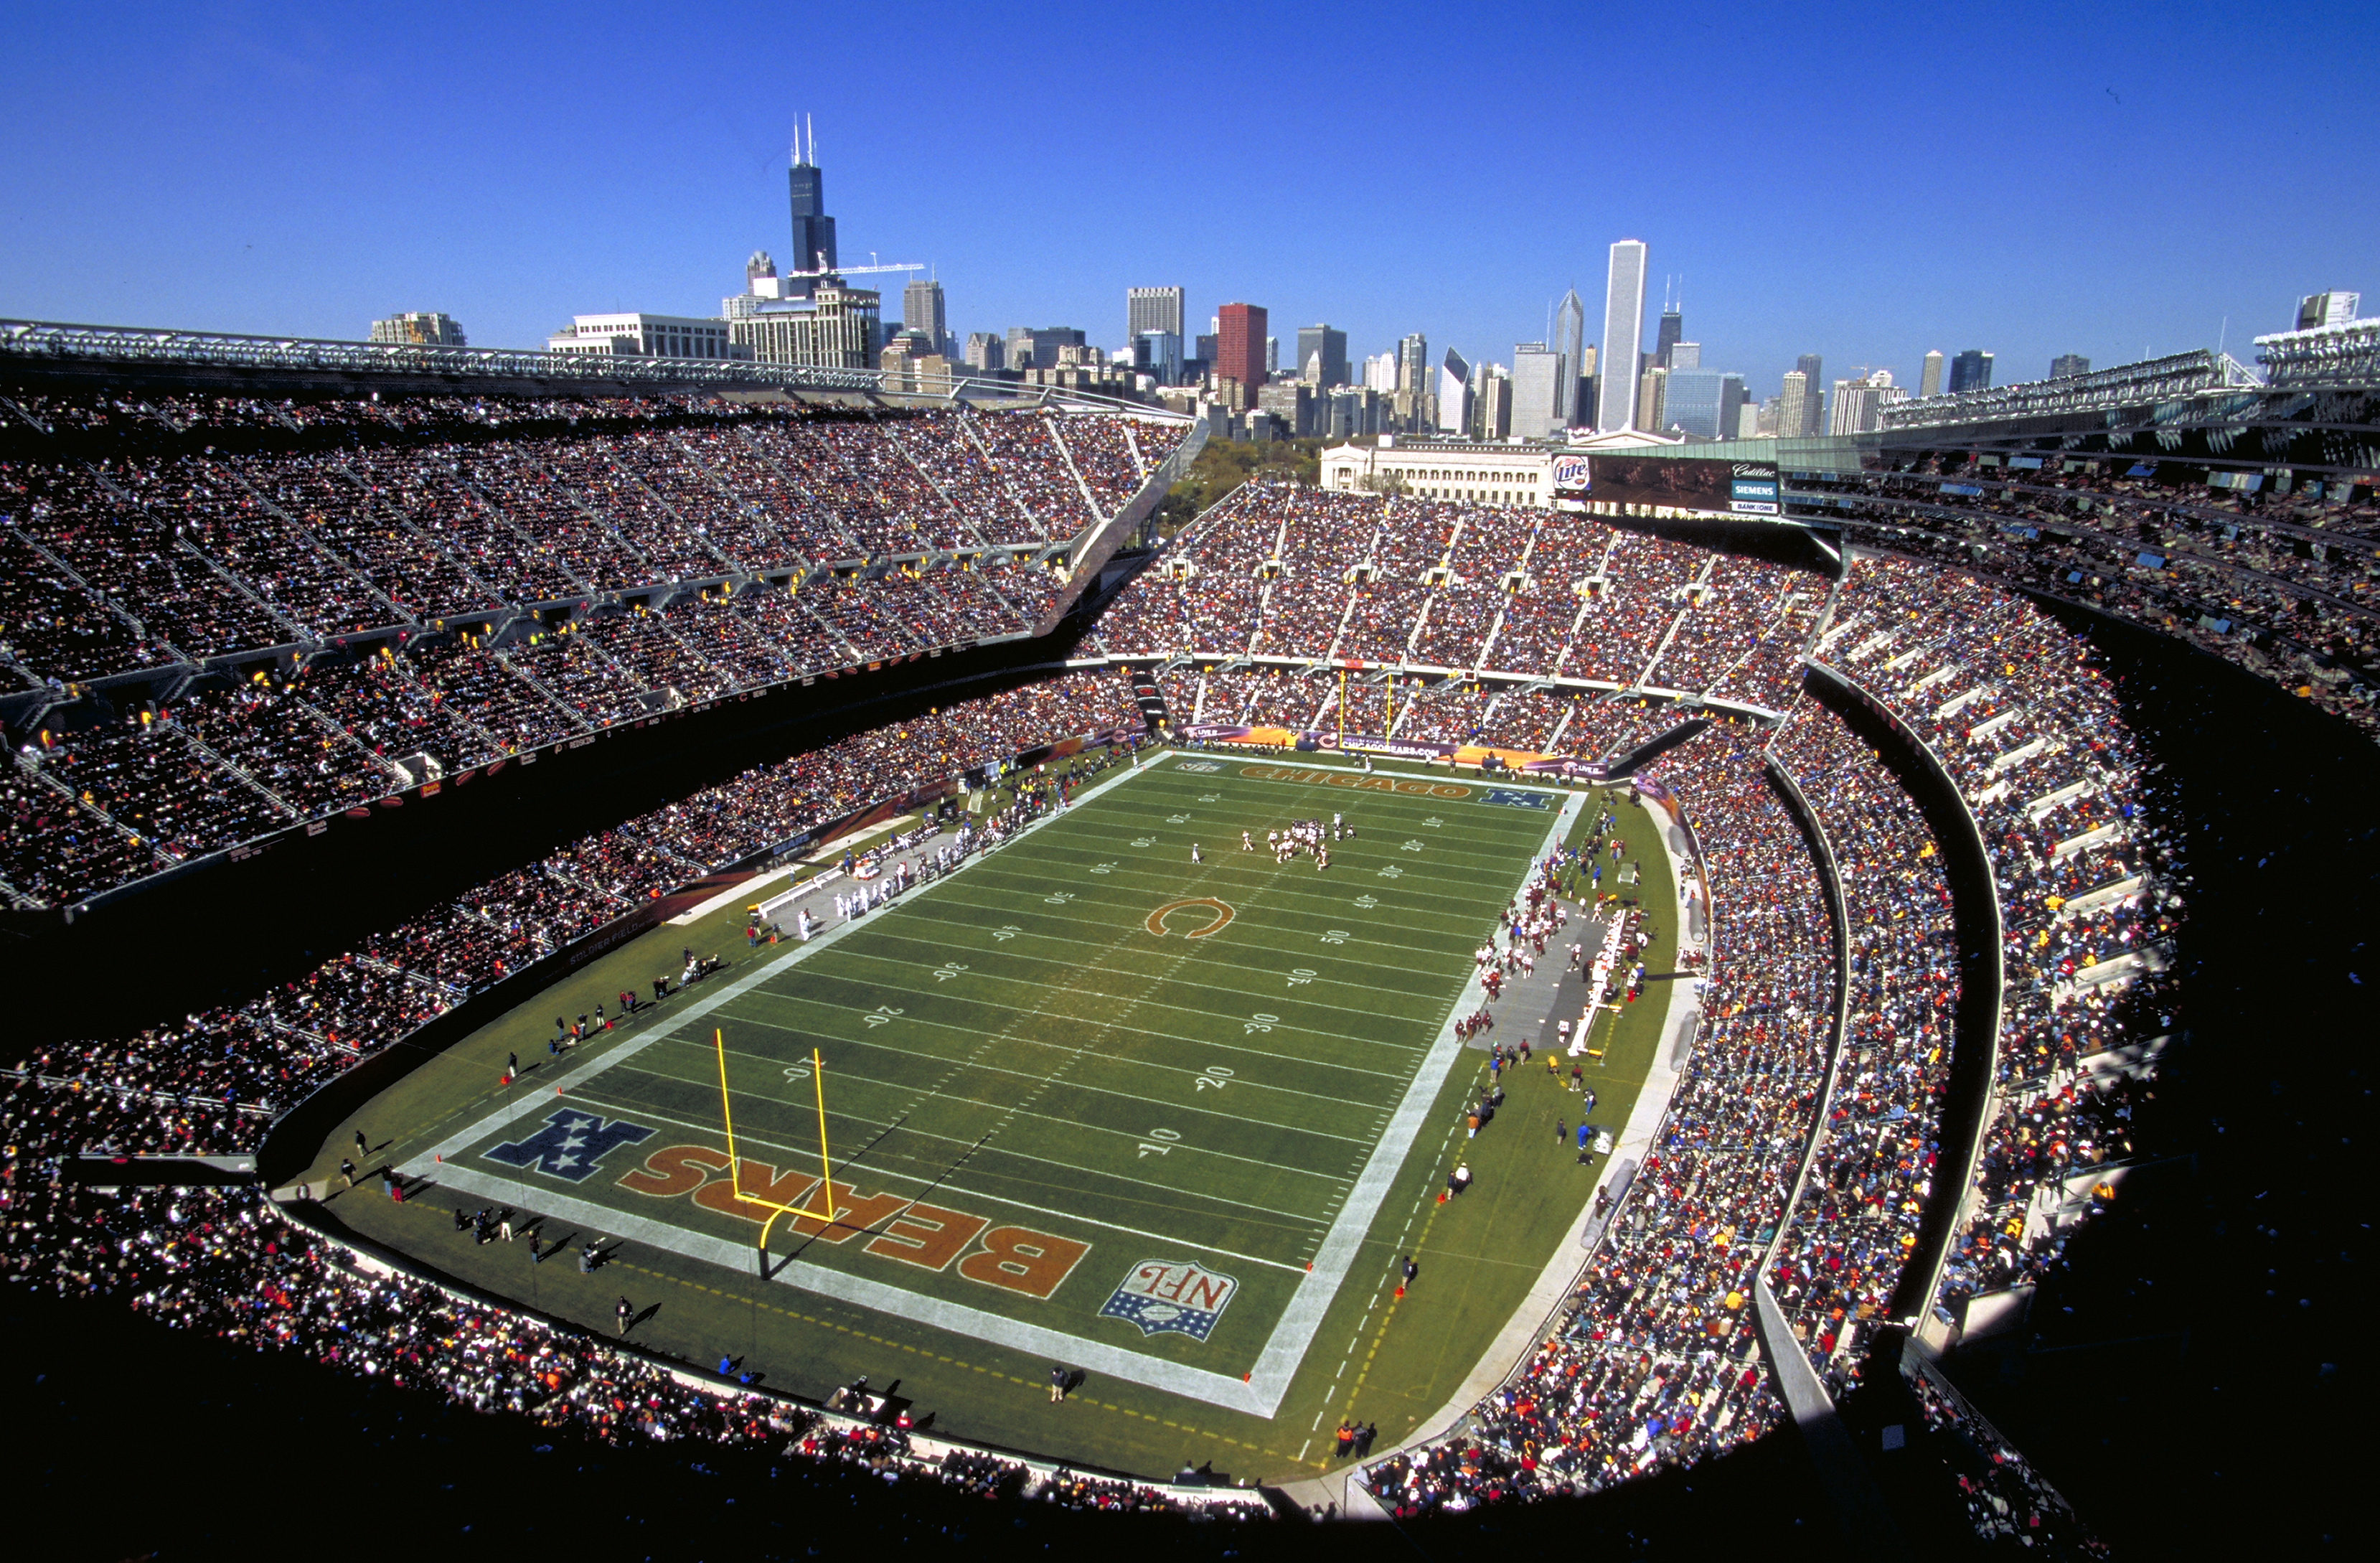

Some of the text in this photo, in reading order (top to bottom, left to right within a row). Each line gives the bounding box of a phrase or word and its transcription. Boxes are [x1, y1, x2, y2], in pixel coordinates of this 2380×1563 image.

[1558, 464, 1586, 482] Lite
[1732, 464, 1775, 477] Cadillac
[1735, 485, 1774, 496] SIEMENS
[569, 735, 596, 749] REDSKINS
[1342, 741, 1439, 758] CHICAGOBEARS.COM
[1240, 766, 1472, 798] CHICAGO
[773, 832, 810, 855] BEARS
[1401, 840, 1424, 852] 20
[1378, 866, 1403, 879] 30
[1044, 891, 1076, 904] 50
[1353, 896, 1378, 909] 40
[992, 925, 1023, 939] 40
[1320, 929, 1350, 945] 50
[570, 922, 638, 966] SOLDIER FIELD
[933, 962, 969, 979] 30
[1287, 968, 1317, 985] 40
[863, 1005, 905, 1025] 20
[1243, 1013, 1279, 1033] 30
[782, 1057, 827, 1078] 10
[1195, 1066, 1235, 1089] 20
[1138, 1128, 1181, 1155] 10
[614, 1145, 1093, 1300] BEARS
[1139, 1265, 1229, 1310] NFL
